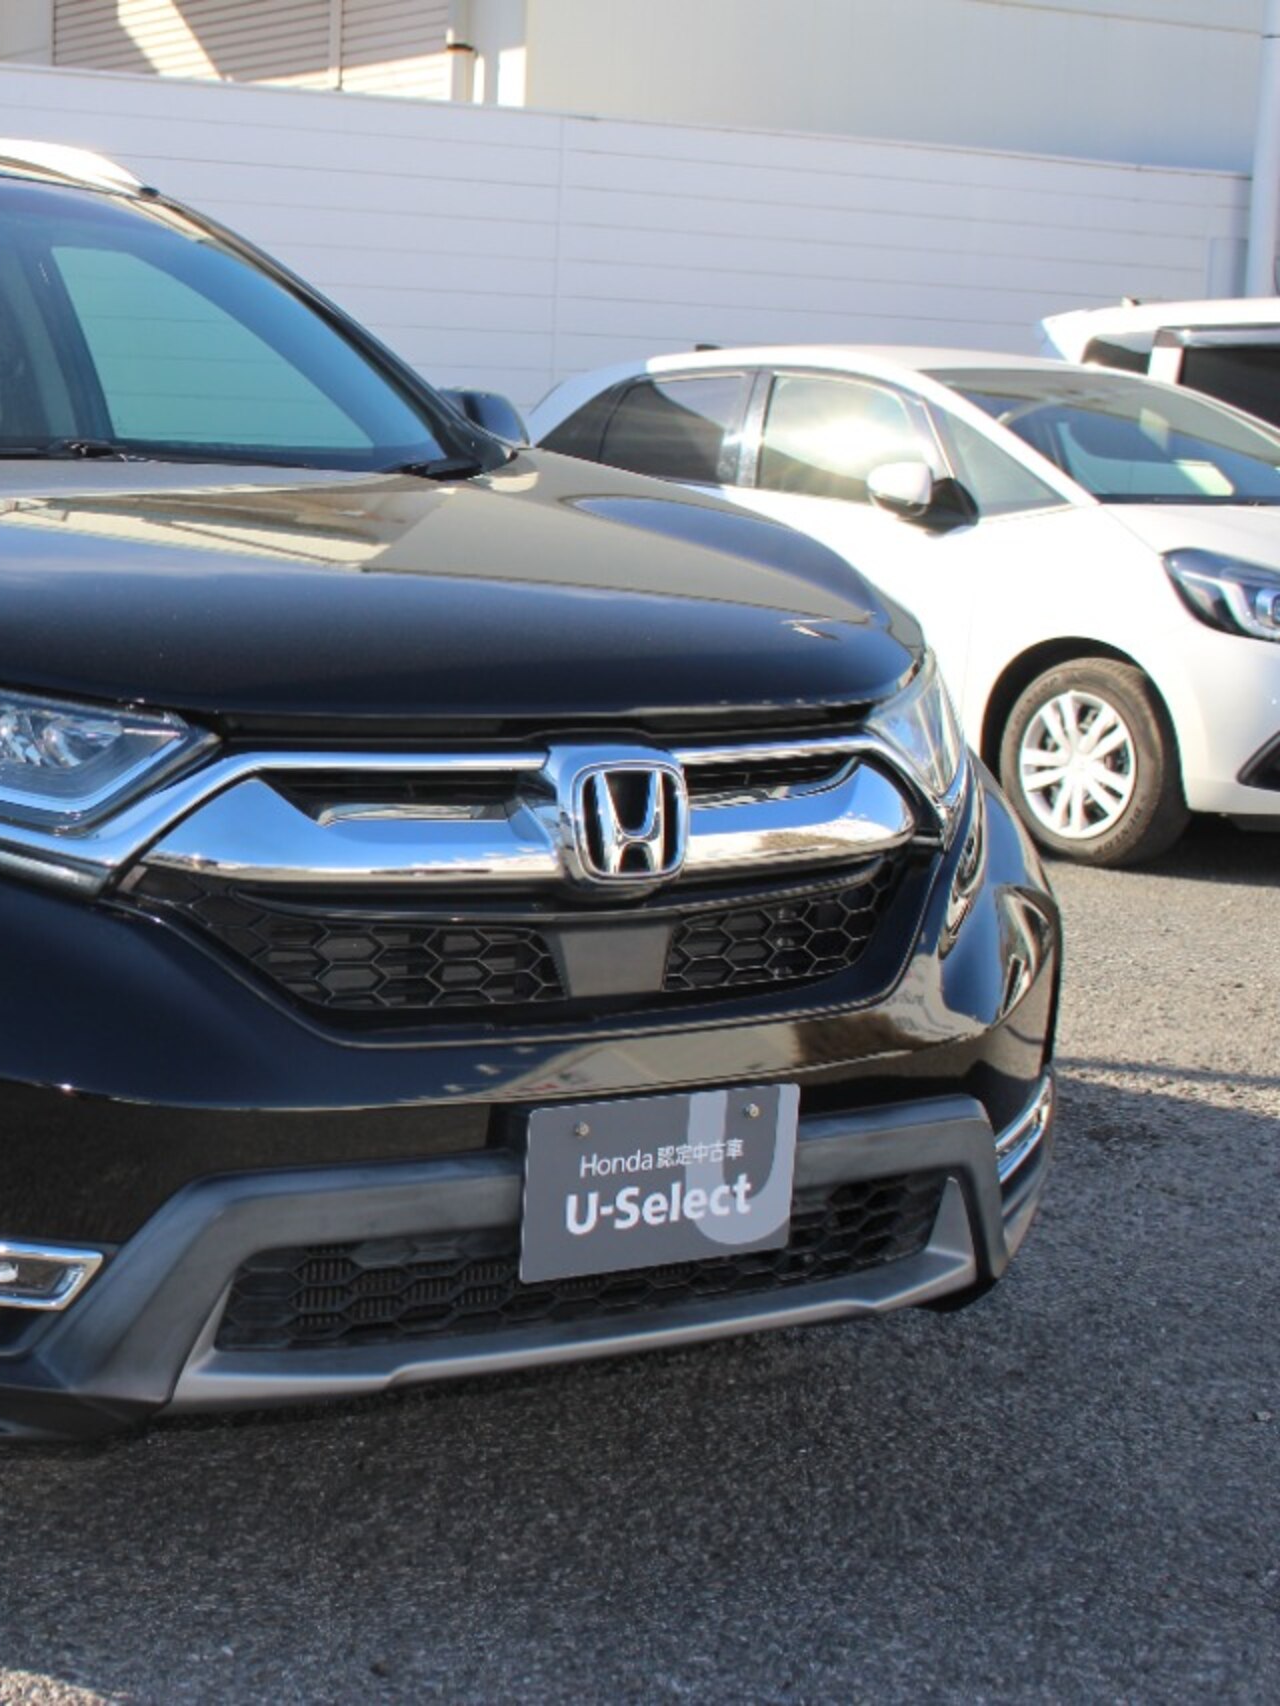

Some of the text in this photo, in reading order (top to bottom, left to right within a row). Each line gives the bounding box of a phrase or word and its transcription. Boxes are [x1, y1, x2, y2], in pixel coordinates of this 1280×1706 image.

[579, 1138, 744, 1178] Honda 認定中古車
[565, 1173, 752, 1236] U-Select
